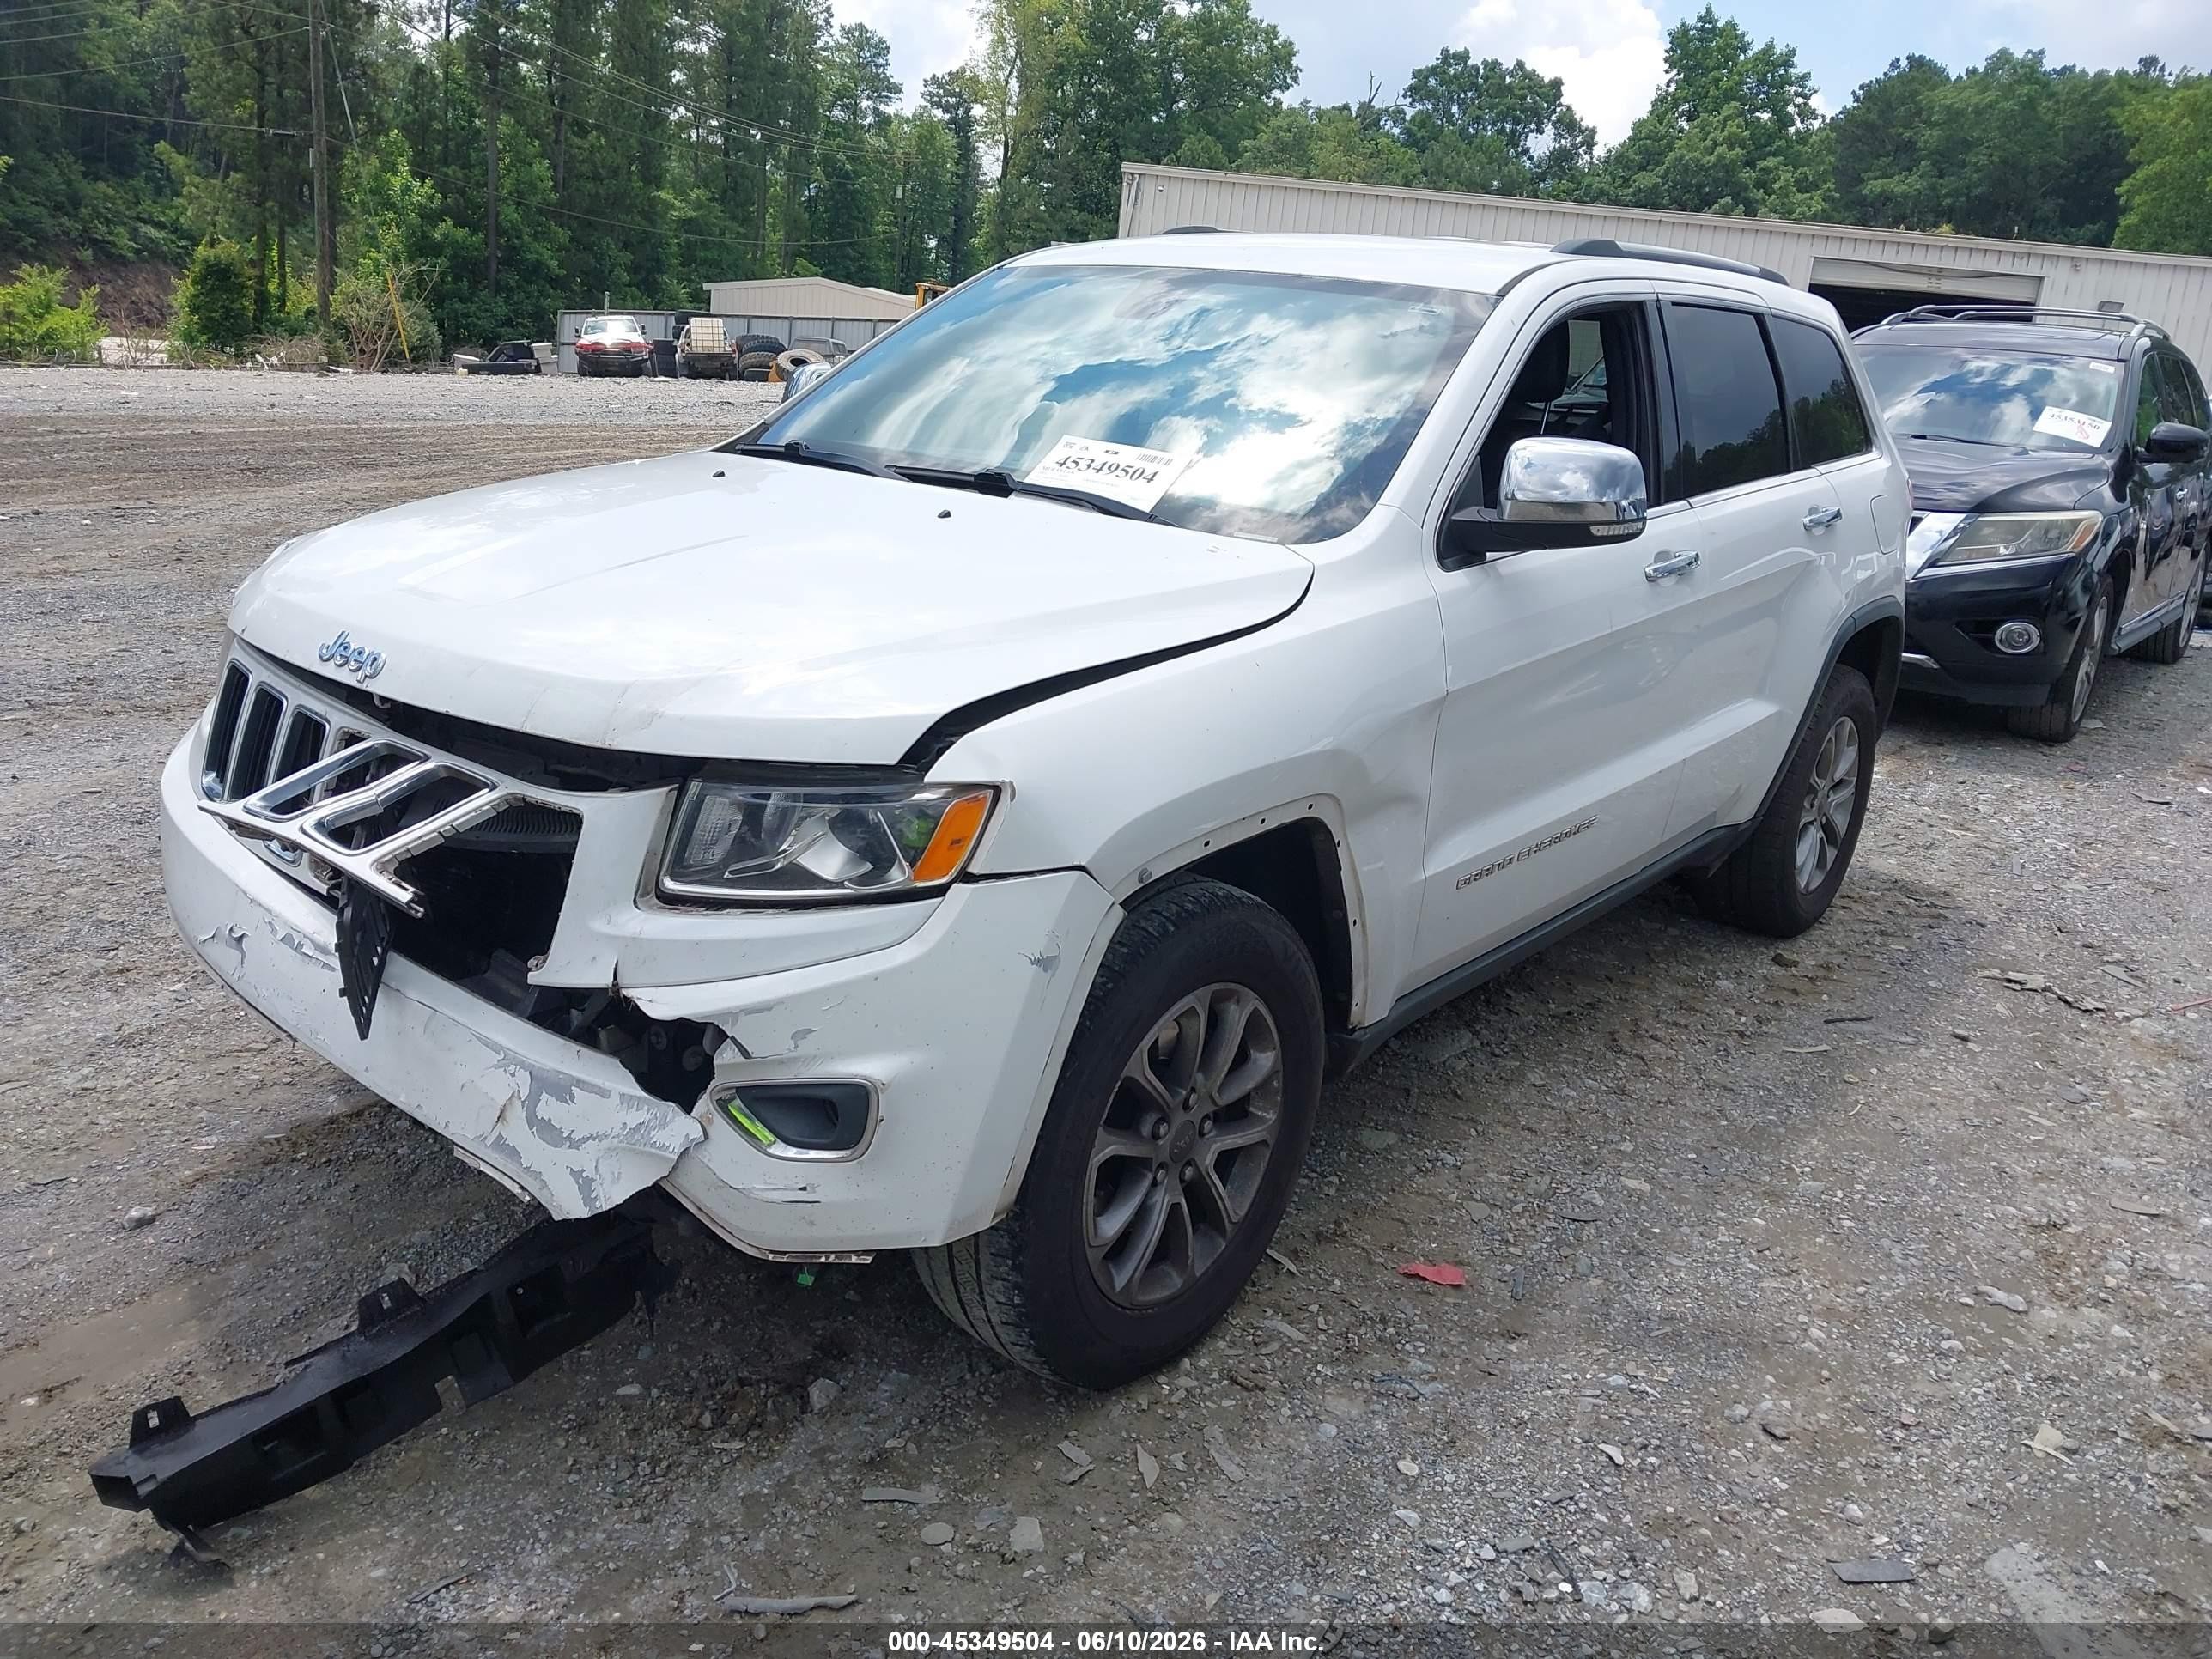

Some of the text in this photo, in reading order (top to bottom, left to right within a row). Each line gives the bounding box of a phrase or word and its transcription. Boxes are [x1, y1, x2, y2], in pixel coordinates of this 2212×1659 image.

[1056, 455, 1159, 483] 45349504
[318, 630, 386, 683] Jeep
[1456, 813, 1601, 890] GRAND CHEROKEE
